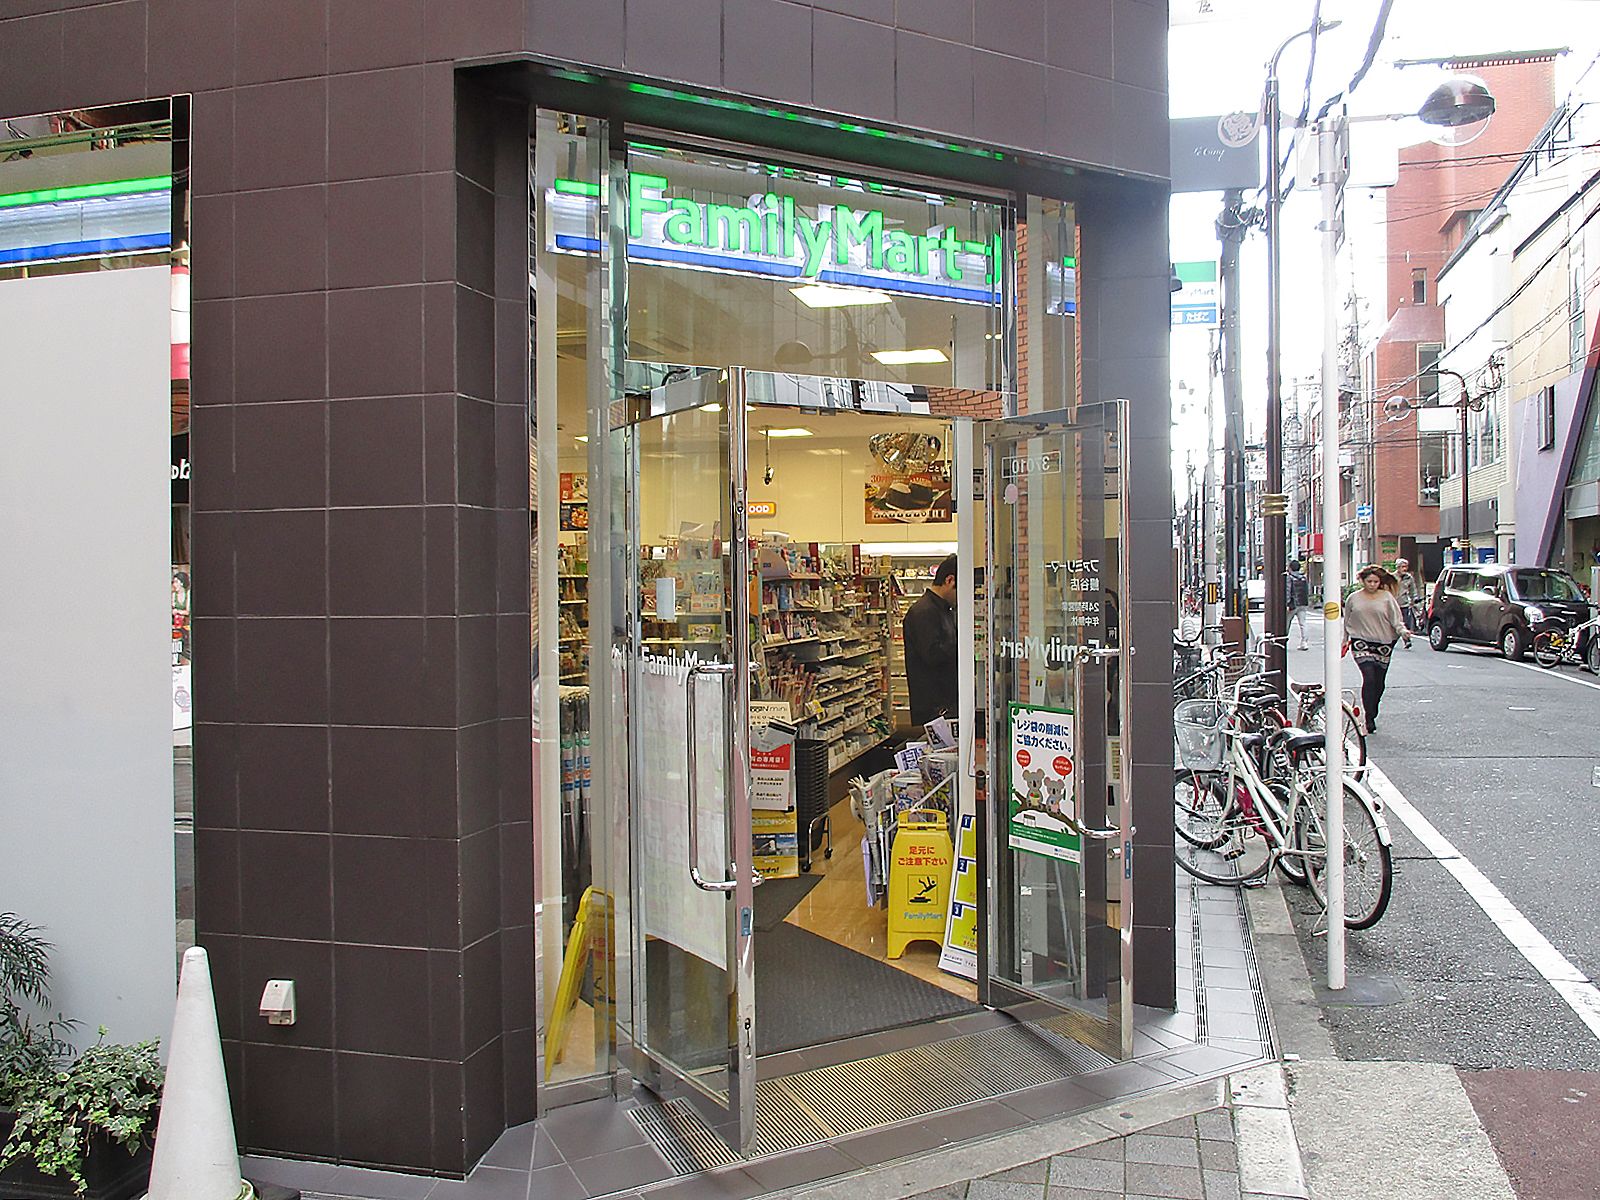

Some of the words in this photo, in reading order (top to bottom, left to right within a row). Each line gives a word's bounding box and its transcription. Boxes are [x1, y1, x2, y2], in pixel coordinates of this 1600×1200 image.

[626, 172, 963, 281] FamilyMart
[748, 504, 770, 514] OOD
[1016, 719, 1069, 737] レジ袋の削減に
[1016, 734, 1072, 753] ご協力ください。
[908, 846, 935, 855] 足元に
[897, 857, 949, 867] ご注意下さい
[903, 911, 944, 920] FamilyMart
